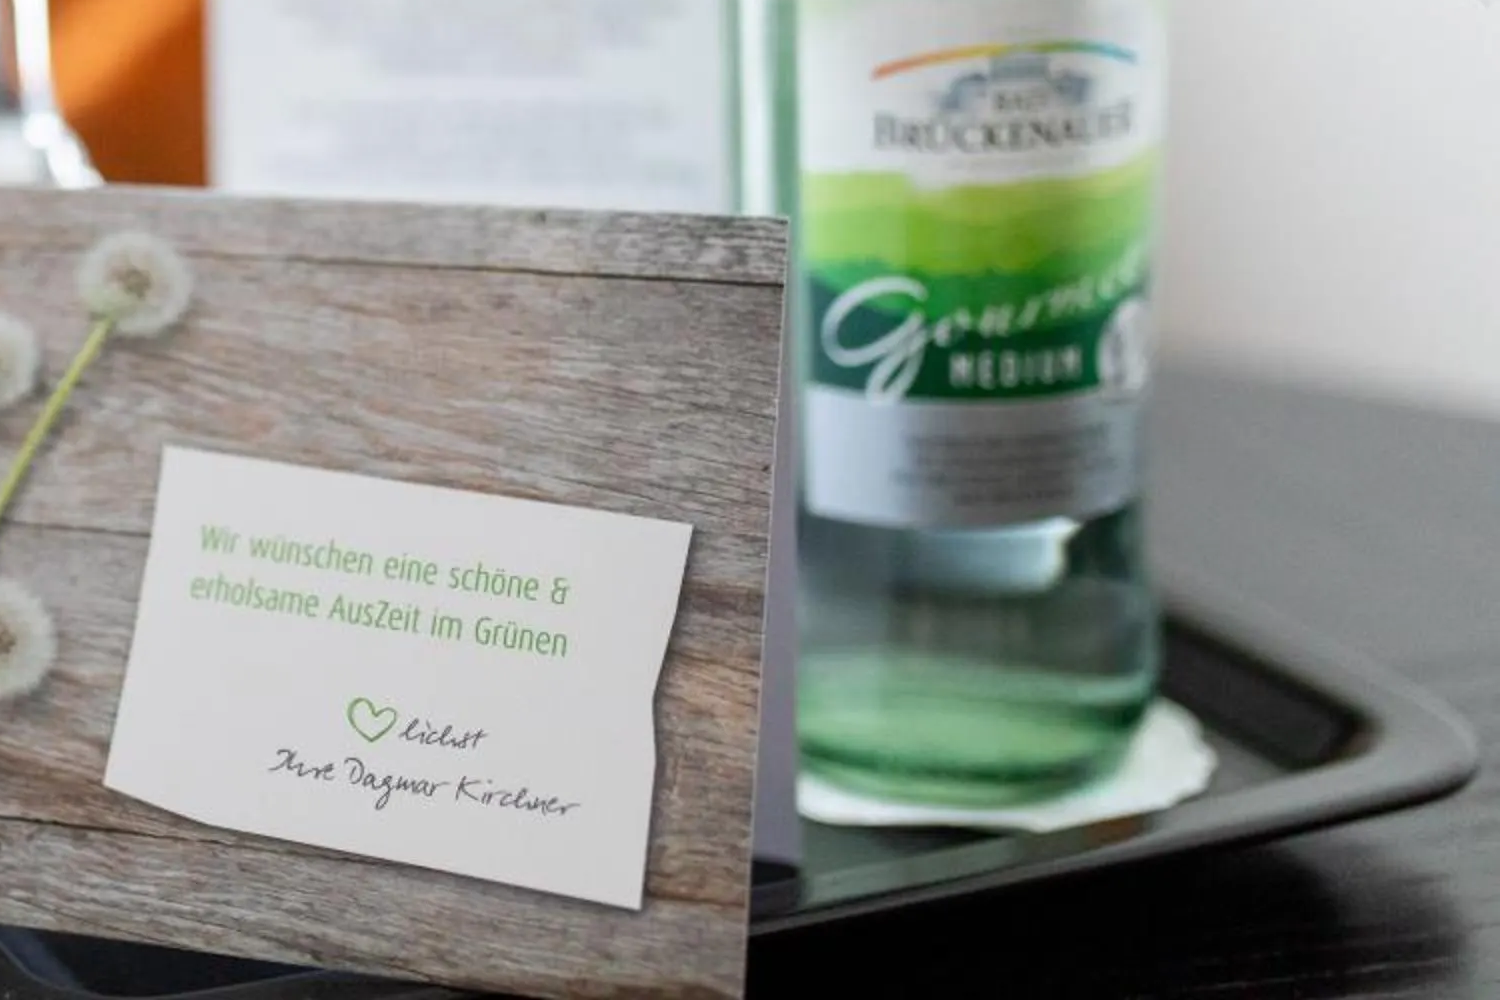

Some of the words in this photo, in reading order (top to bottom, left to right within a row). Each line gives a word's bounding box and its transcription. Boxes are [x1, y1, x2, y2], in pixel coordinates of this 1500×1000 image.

[948, 345, 1083, 389] MEDIUM
[201, 524, 241, 553] Wir
[249, 533, 374, 575] wünschen
[383, 553, 439, 586] eine
[448, 560, 540, 602] schöne
[550, 575, 571, 605] &
[189, 574, 320, 618] erholsame
[327, 593, 421, 634] AusZeit
[430, 608, 463, 641] im
[474, 616, 569, 658] Grünen
[398, 717, 489, 750] lichst
[343, 756, 450, 809] Dagmar
[454, 775, 582, 816] Kirchner
